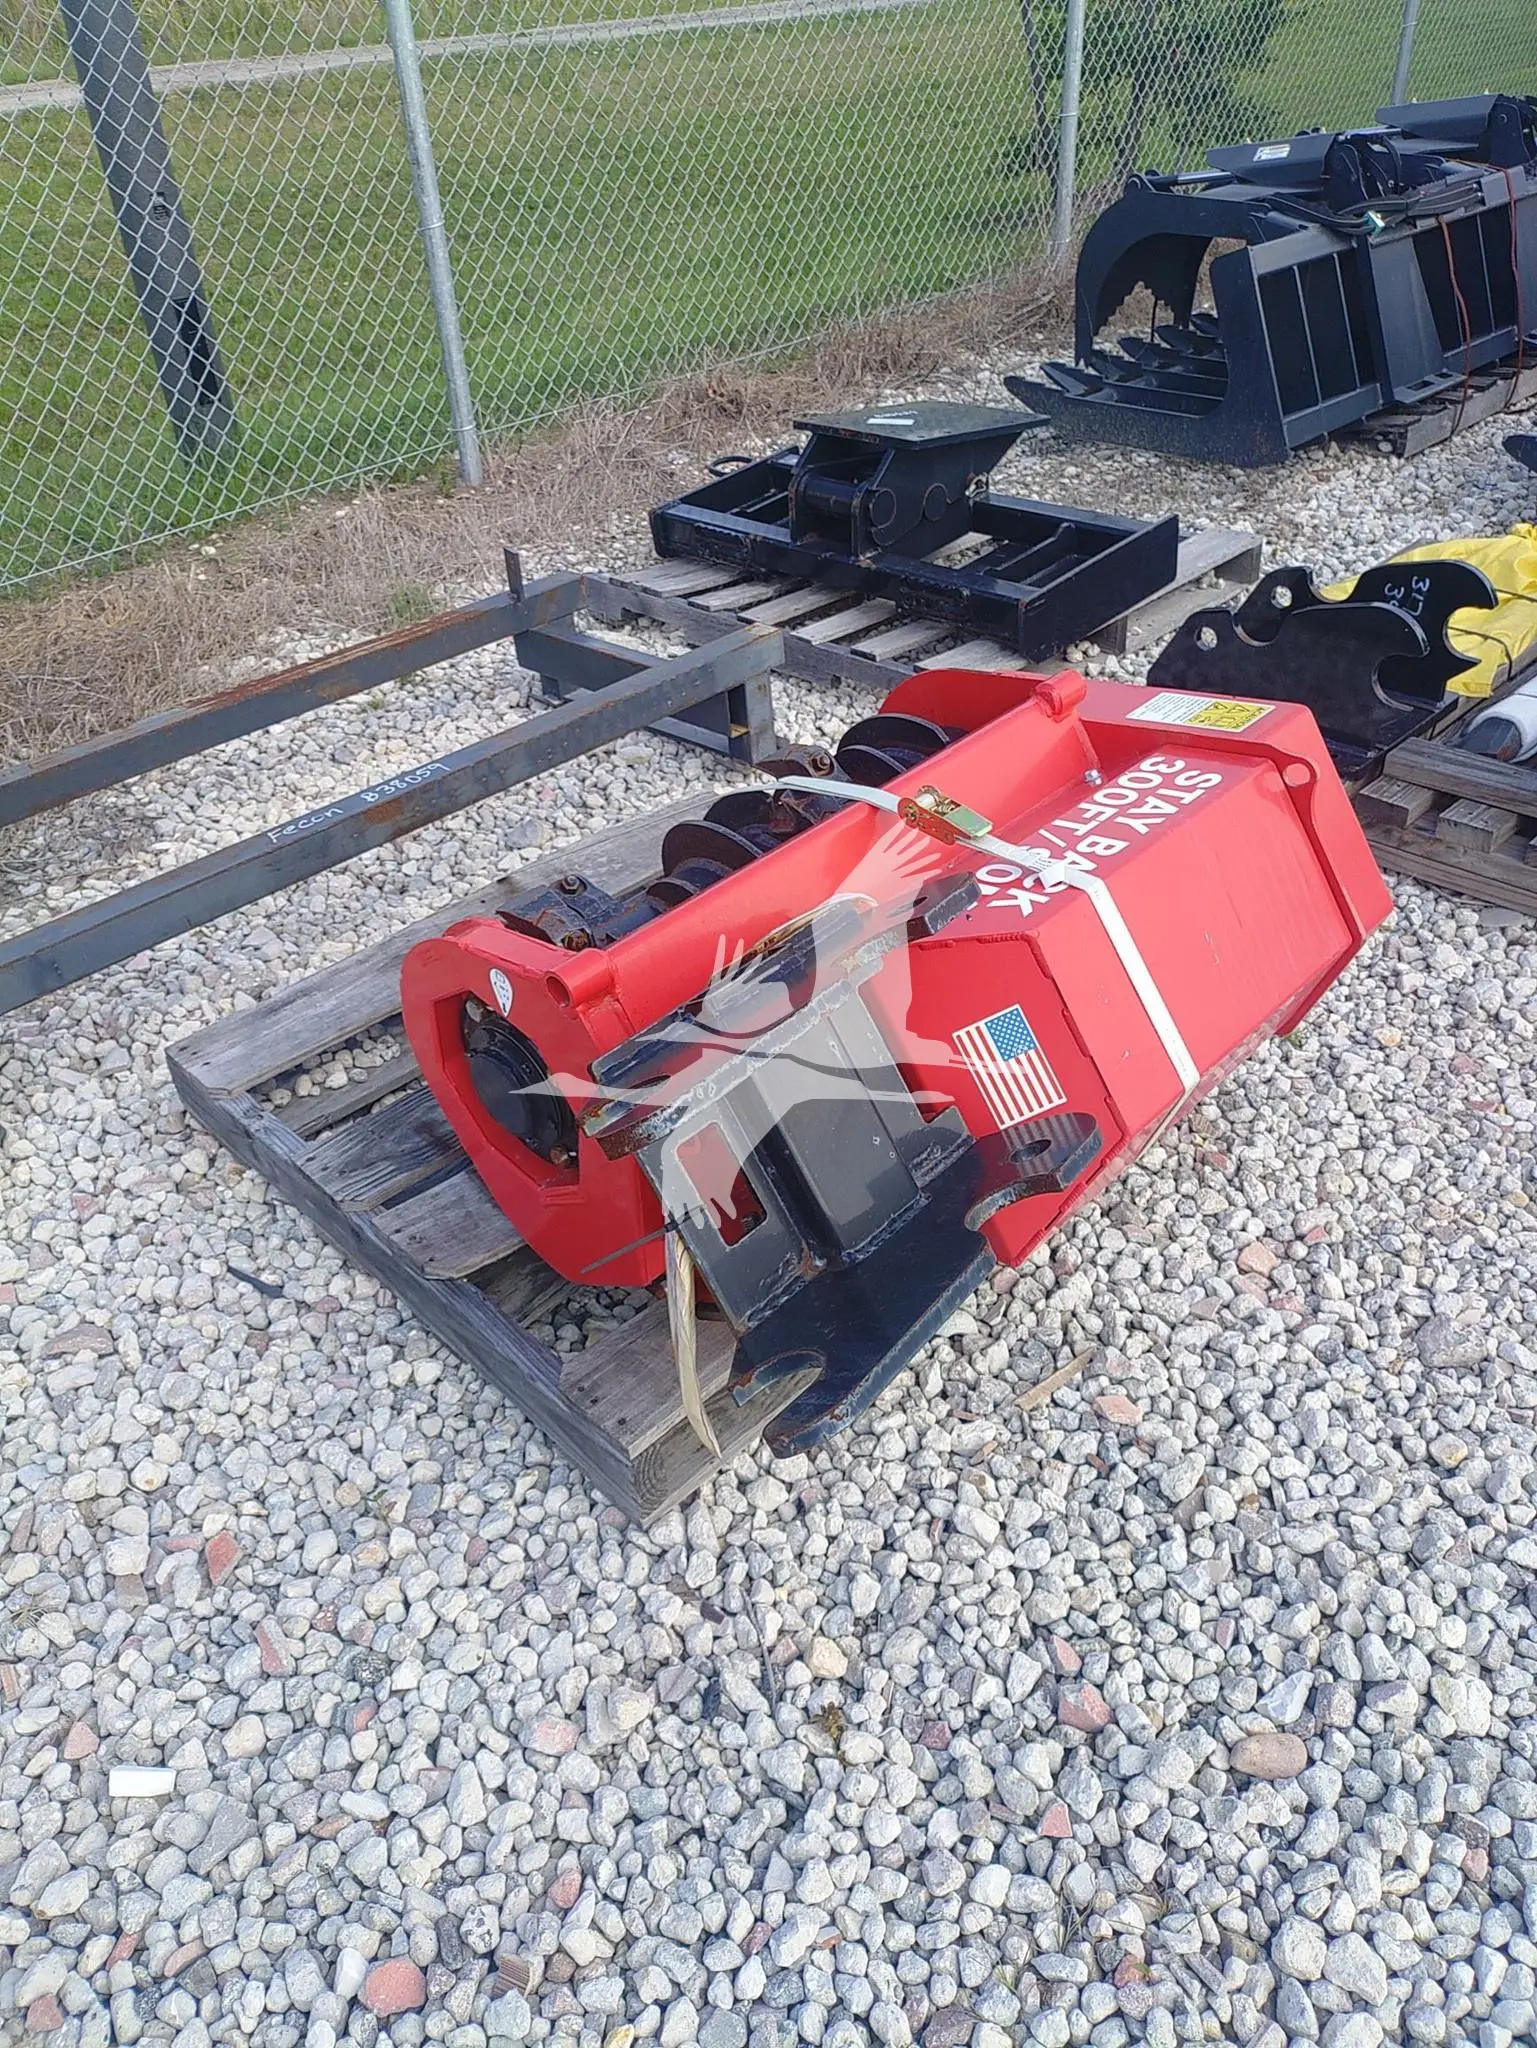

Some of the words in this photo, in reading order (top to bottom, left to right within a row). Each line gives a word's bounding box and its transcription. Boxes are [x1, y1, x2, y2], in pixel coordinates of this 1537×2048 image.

[1402, 576, 1430, 616] 317
[266, 807, 344, 844] Fecon
[1113, 769, 1223, 835] STAY
[966, 756, 1187, 911] 300FT/0
